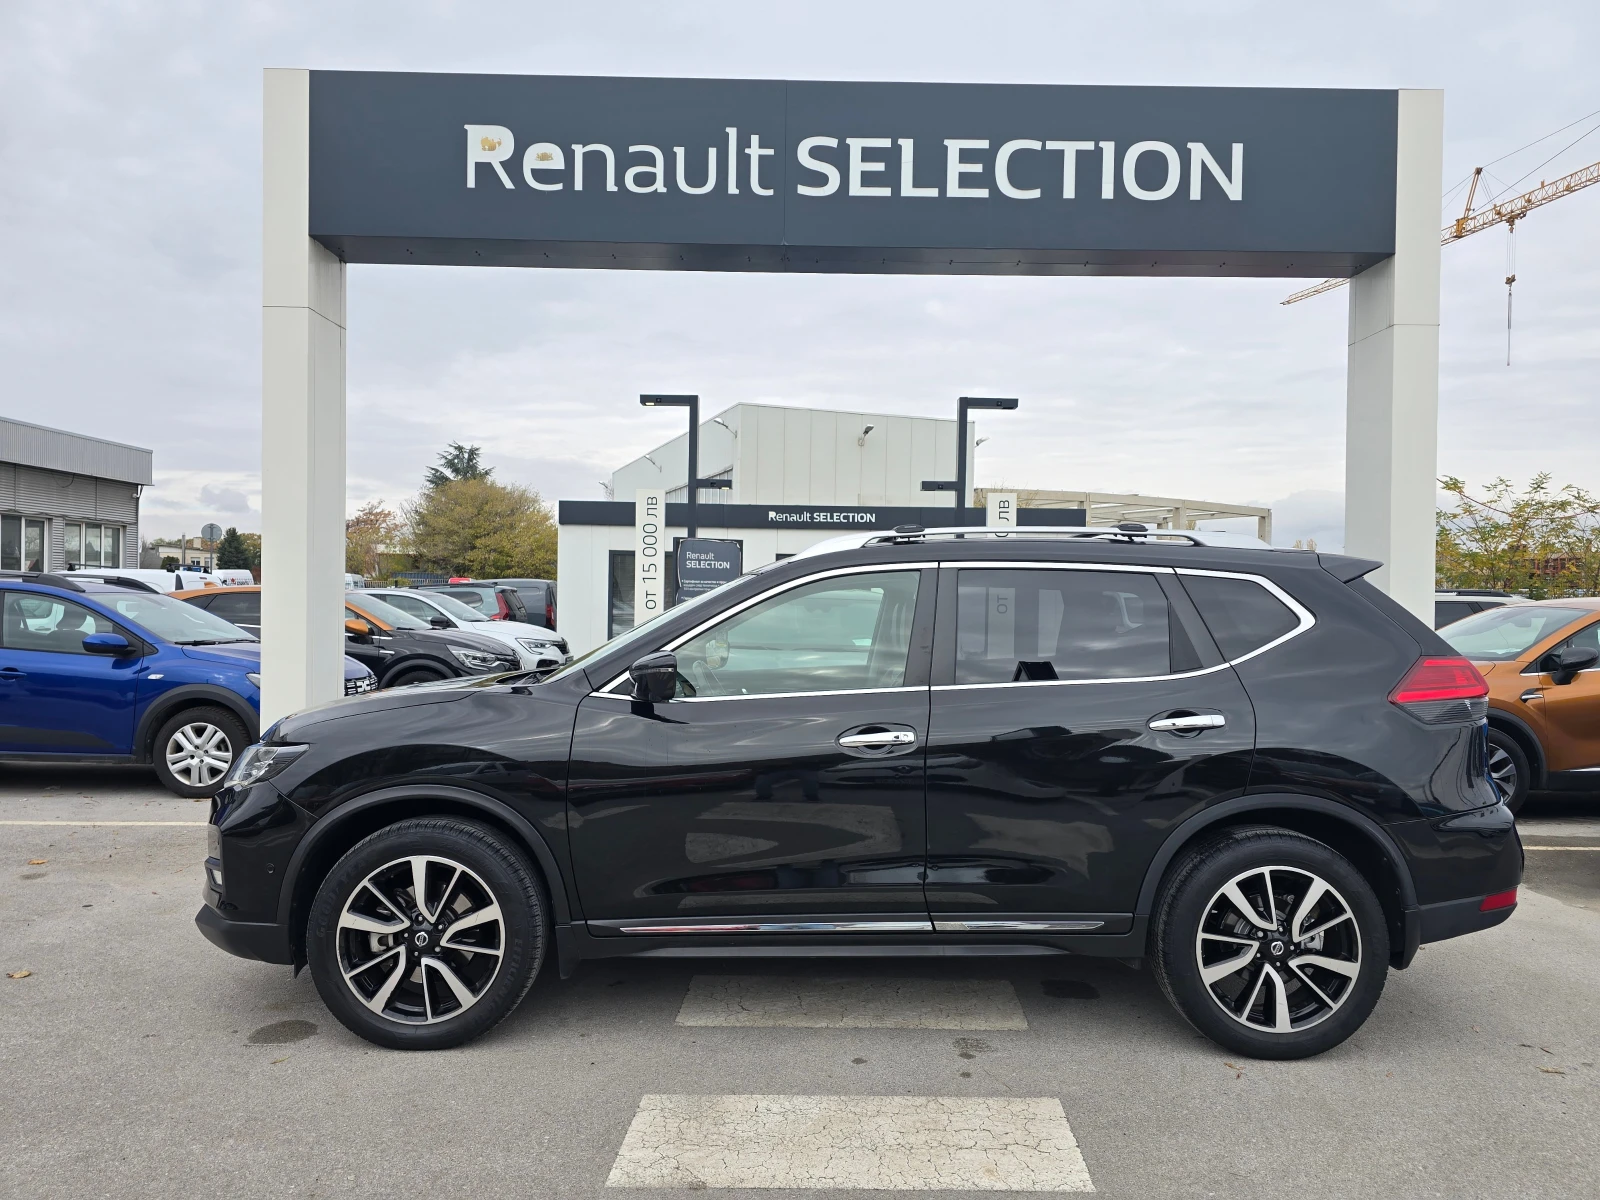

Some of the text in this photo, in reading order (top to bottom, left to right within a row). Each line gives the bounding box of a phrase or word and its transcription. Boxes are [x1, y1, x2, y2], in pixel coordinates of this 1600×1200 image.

[464, 124, 1245, 202] Renault SELECTION
[768, 511, 876, 523] Renault SELECTION
[642, 523, 658, 558] 000
[686, 552, 714, 560] Renault
[686, 561, 730, 569] SELECTION
[642, 563, 657, 584] 15
